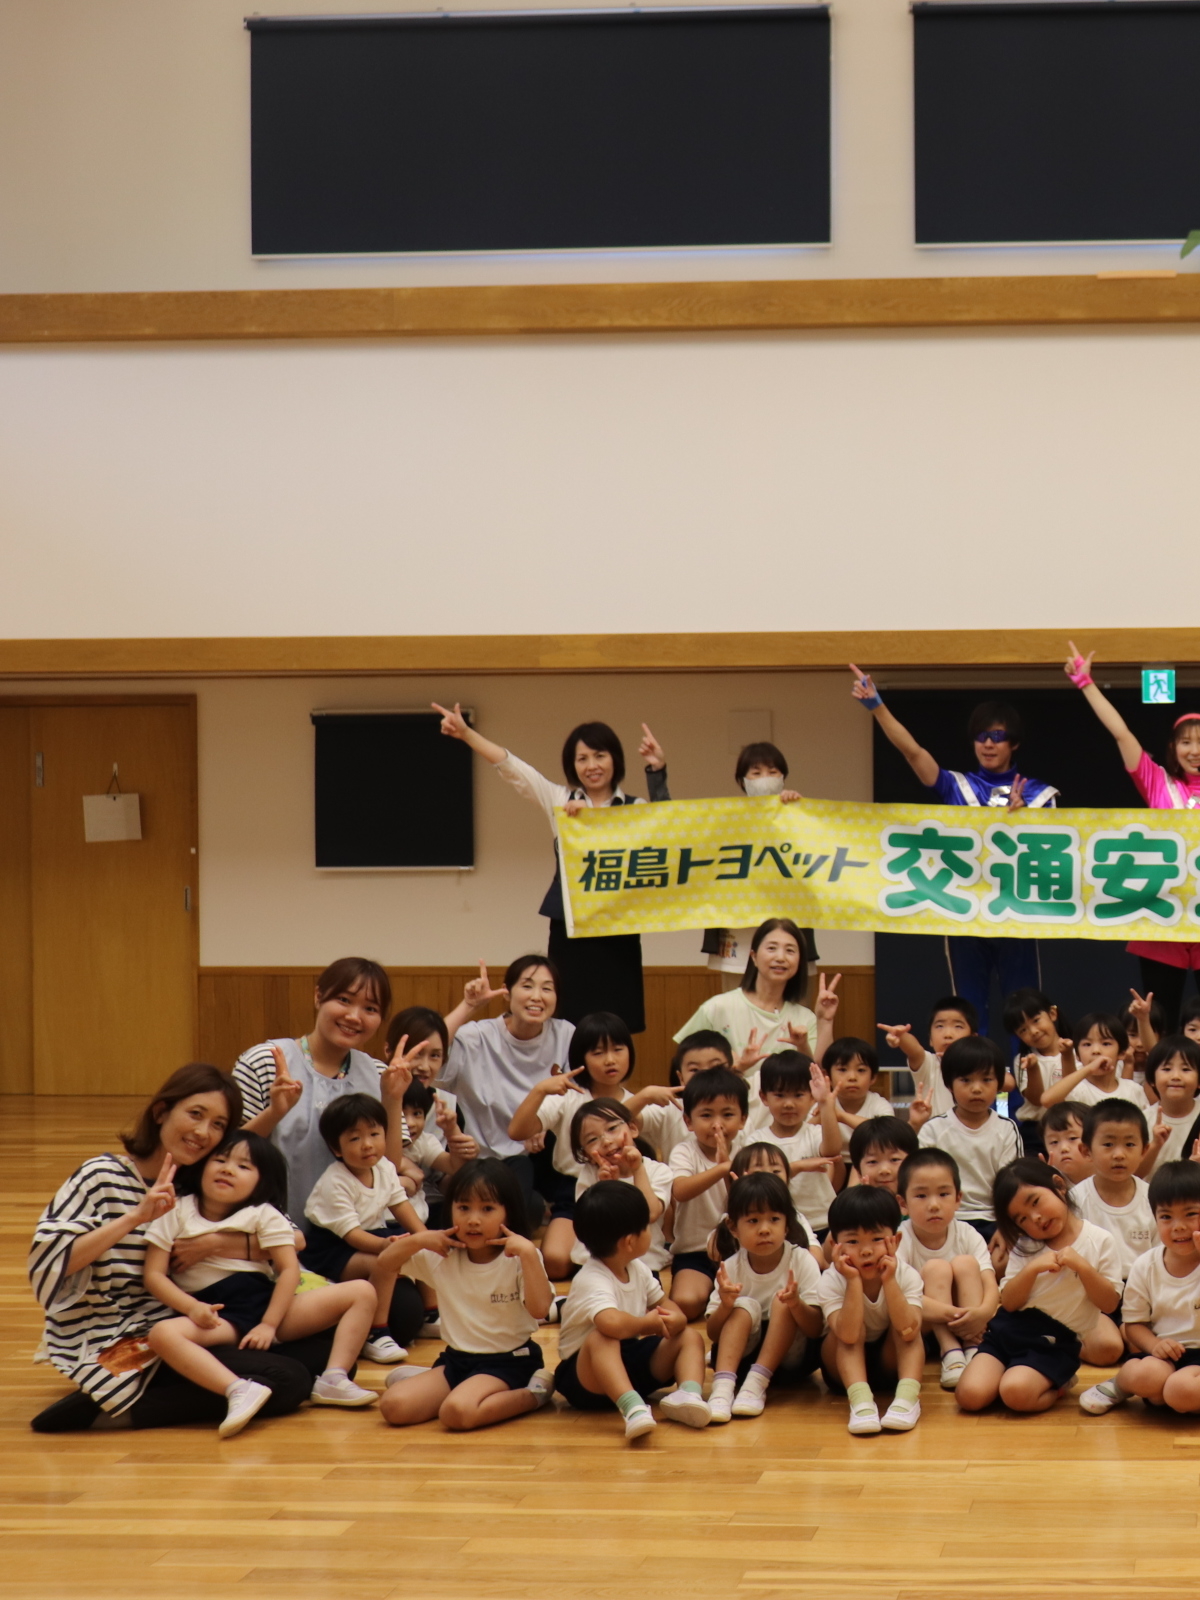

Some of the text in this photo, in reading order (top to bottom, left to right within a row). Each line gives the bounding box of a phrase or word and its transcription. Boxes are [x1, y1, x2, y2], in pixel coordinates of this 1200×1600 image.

[579, 843, 869, 892] 福島トヨペット
